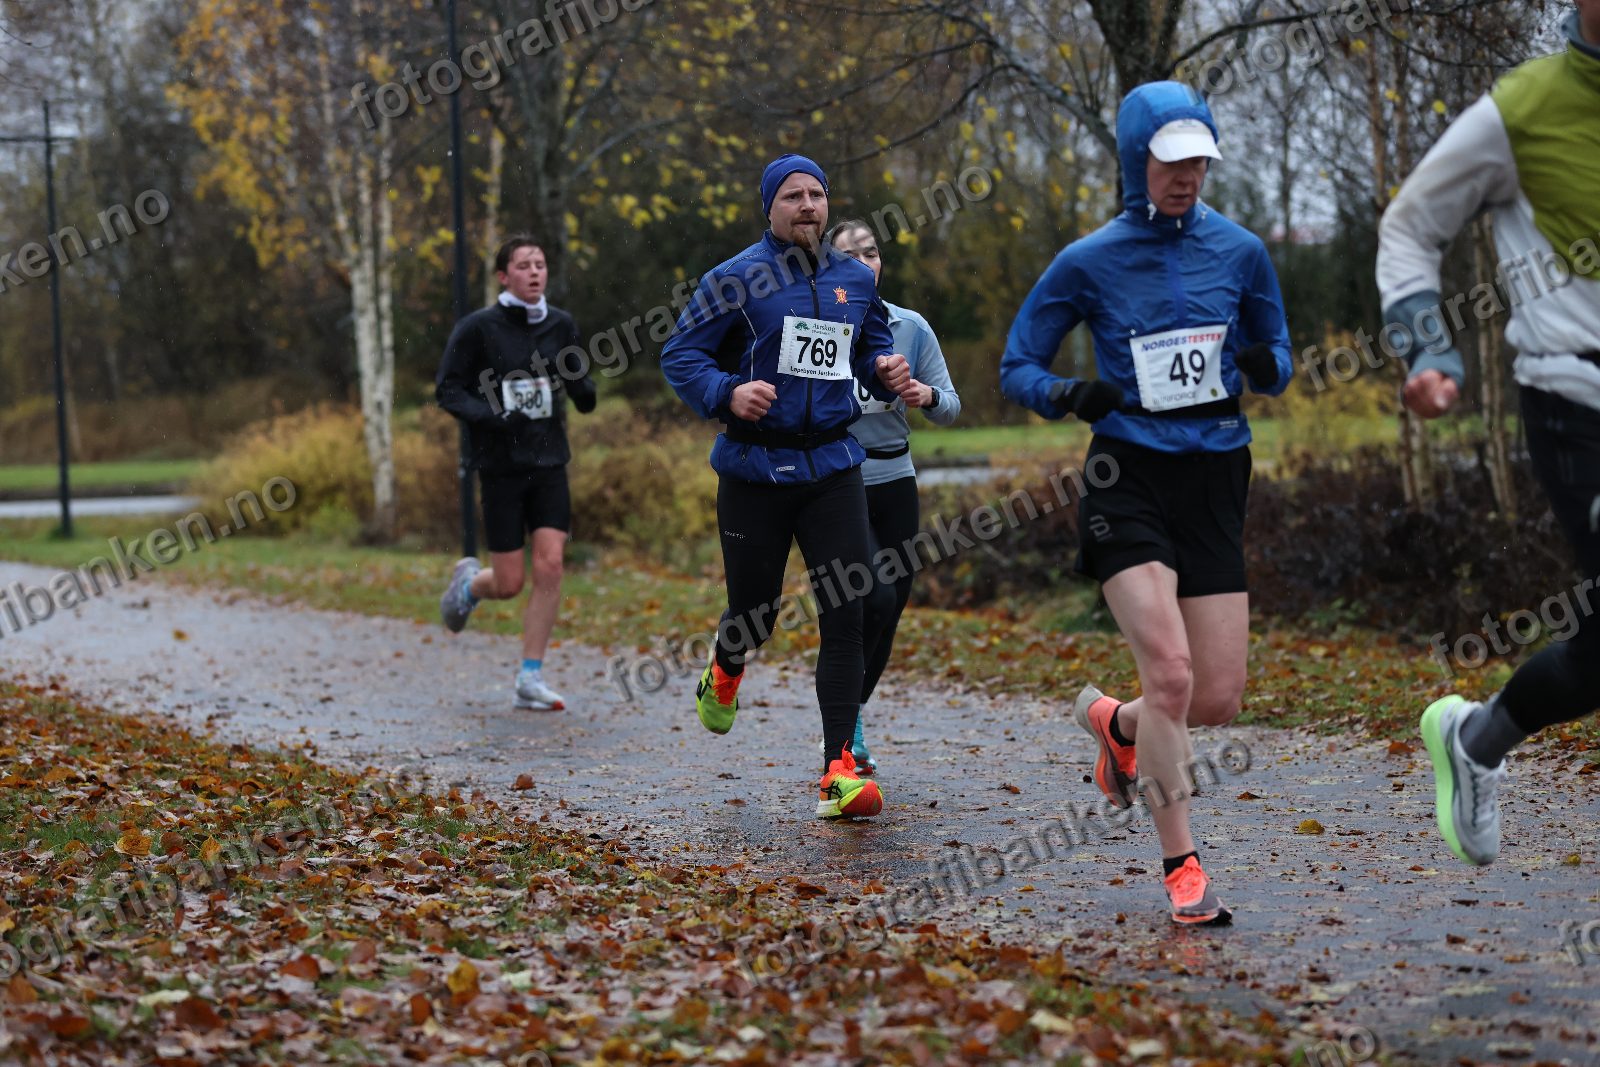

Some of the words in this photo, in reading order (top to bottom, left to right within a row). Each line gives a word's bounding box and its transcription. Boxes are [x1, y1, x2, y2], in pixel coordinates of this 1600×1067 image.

[796, 335, 838, 369] 769
[1169, 349, 1206, 387] 49
[514, 390, 543, 410] 380
